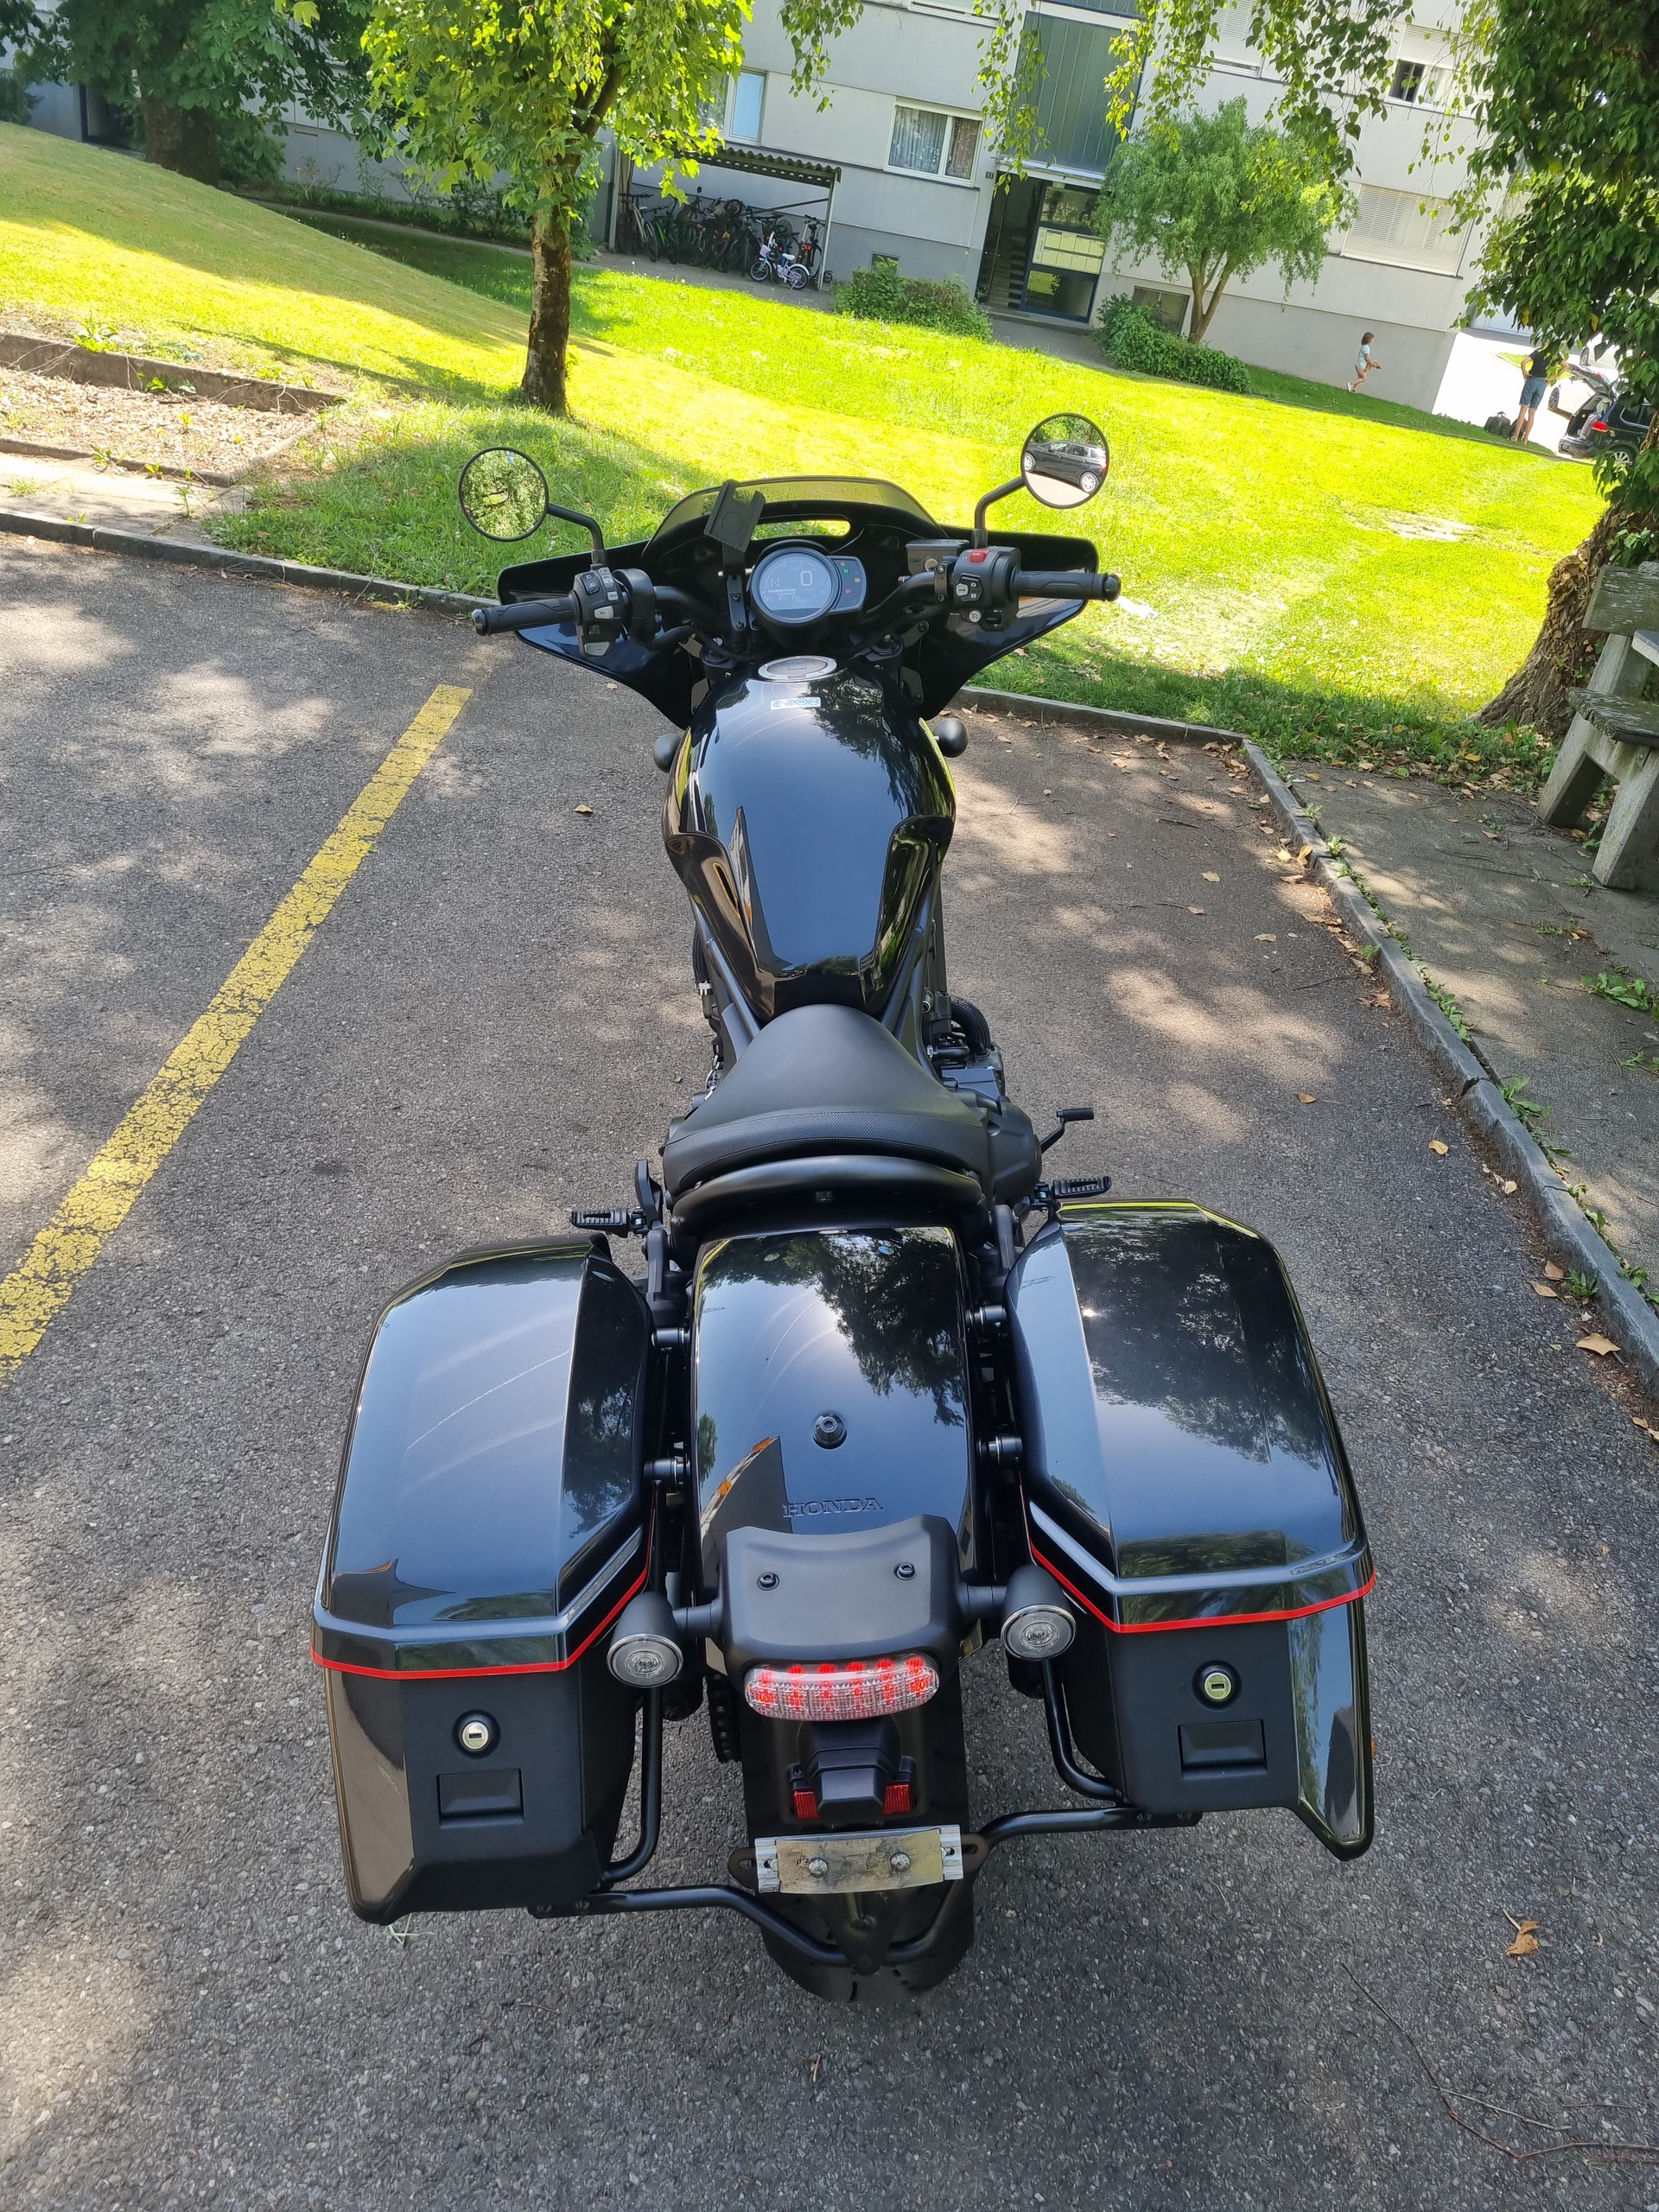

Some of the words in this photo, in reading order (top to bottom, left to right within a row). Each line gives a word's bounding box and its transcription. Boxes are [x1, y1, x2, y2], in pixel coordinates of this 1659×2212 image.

[770, 578, 780, 588] N
[800, 570, 813, 587] 0
[782, 1497, 884, 1518] HONDA
